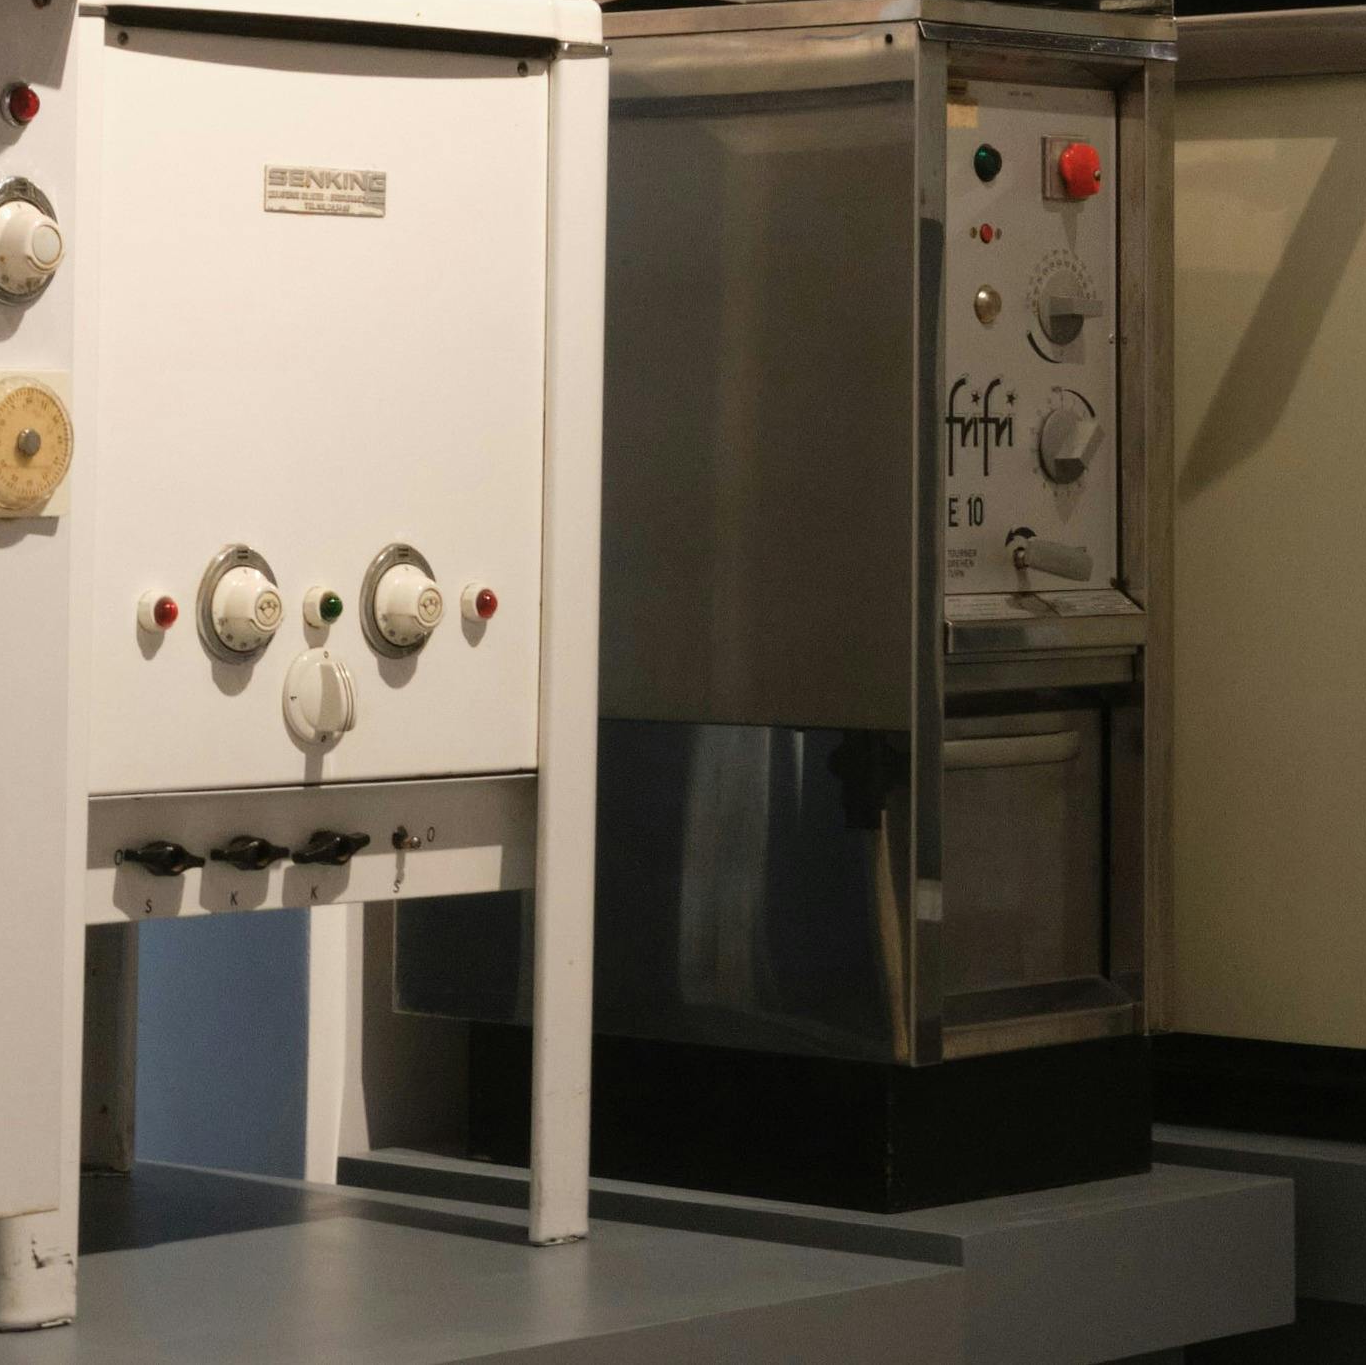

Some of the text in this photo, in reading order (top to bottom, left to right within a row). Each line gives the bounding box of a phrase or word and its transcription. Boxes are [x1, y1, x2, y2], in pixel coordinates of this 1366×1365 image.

[268, 168, 387, 192] SENKING
[945, 375, 1015, 476] frifri
[948, 496, 984, 527] E 10
[230, 891, 239, 906] K
[310, 884, 319, 899] K
[145, 900, 152, 914] S
